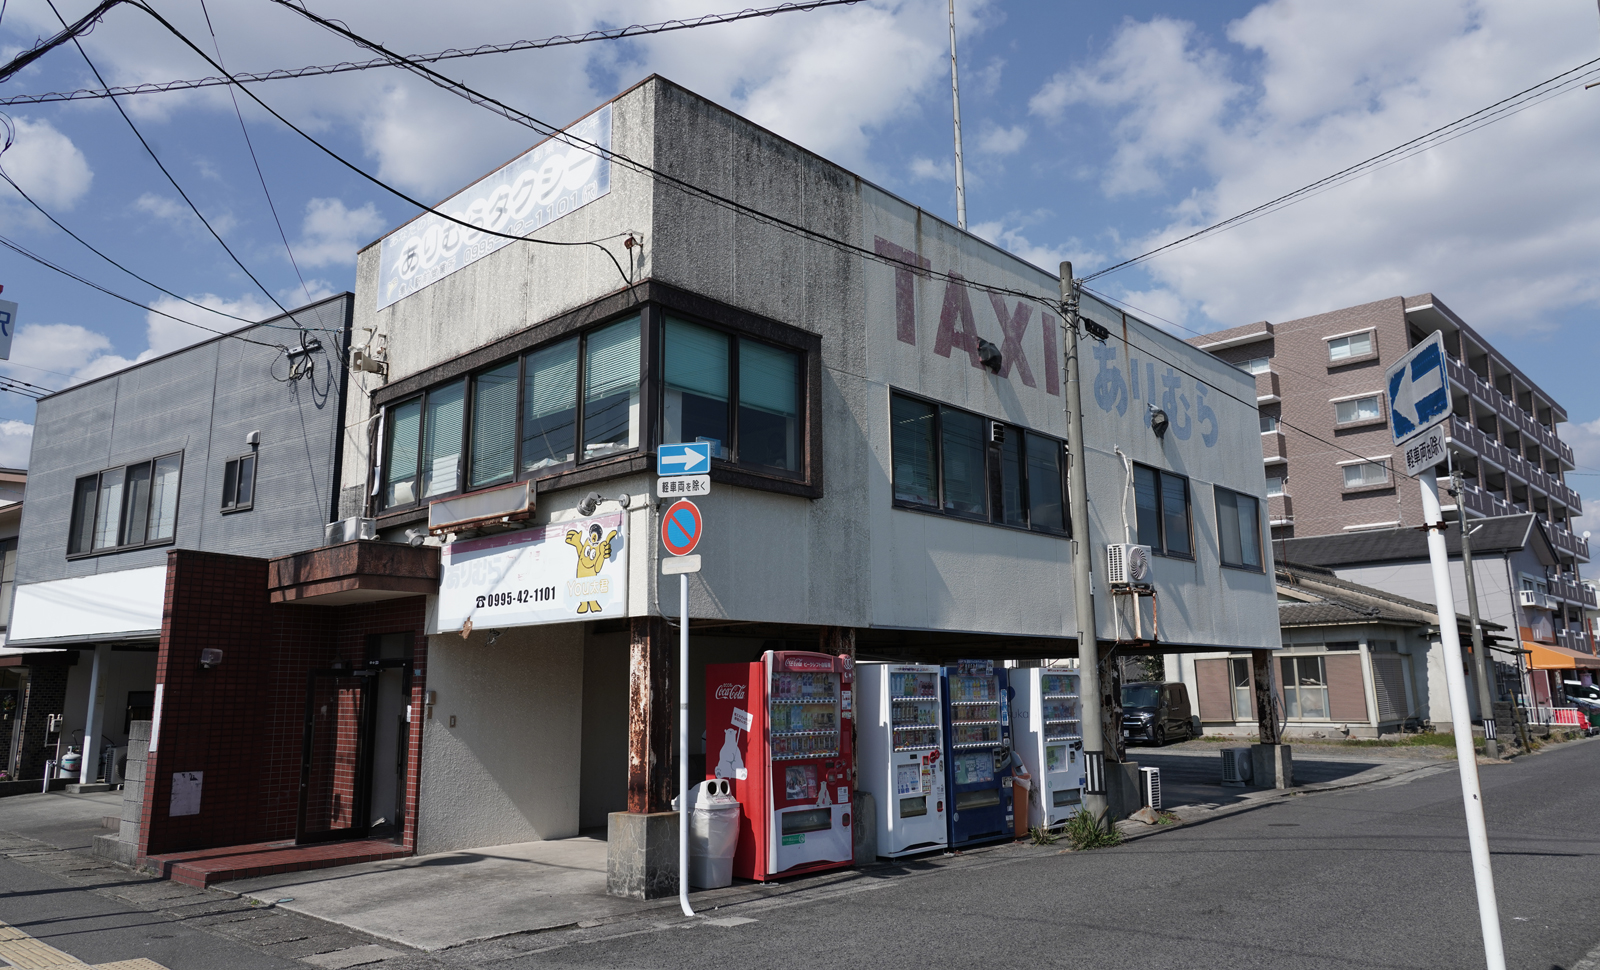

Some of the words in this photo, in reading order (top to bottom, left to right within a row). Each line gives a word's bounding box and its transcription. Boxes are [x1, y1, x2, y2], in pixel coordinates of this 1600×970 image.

[401, 154, 592, 277] ありむらタクシー
[874, 235, 1060, 397] TAXI
[1092, 345, 1219, 448] ありむら
[1406, 435, 1444, 470] 軽車両を除く
[661, 479, 707, 493] 軽車両を除く
[445, 556, 503, 590] ありむら
[488, 586, 556, 608] 0995-42-1101
[715, 684, 747, 700] Coca-Cola
